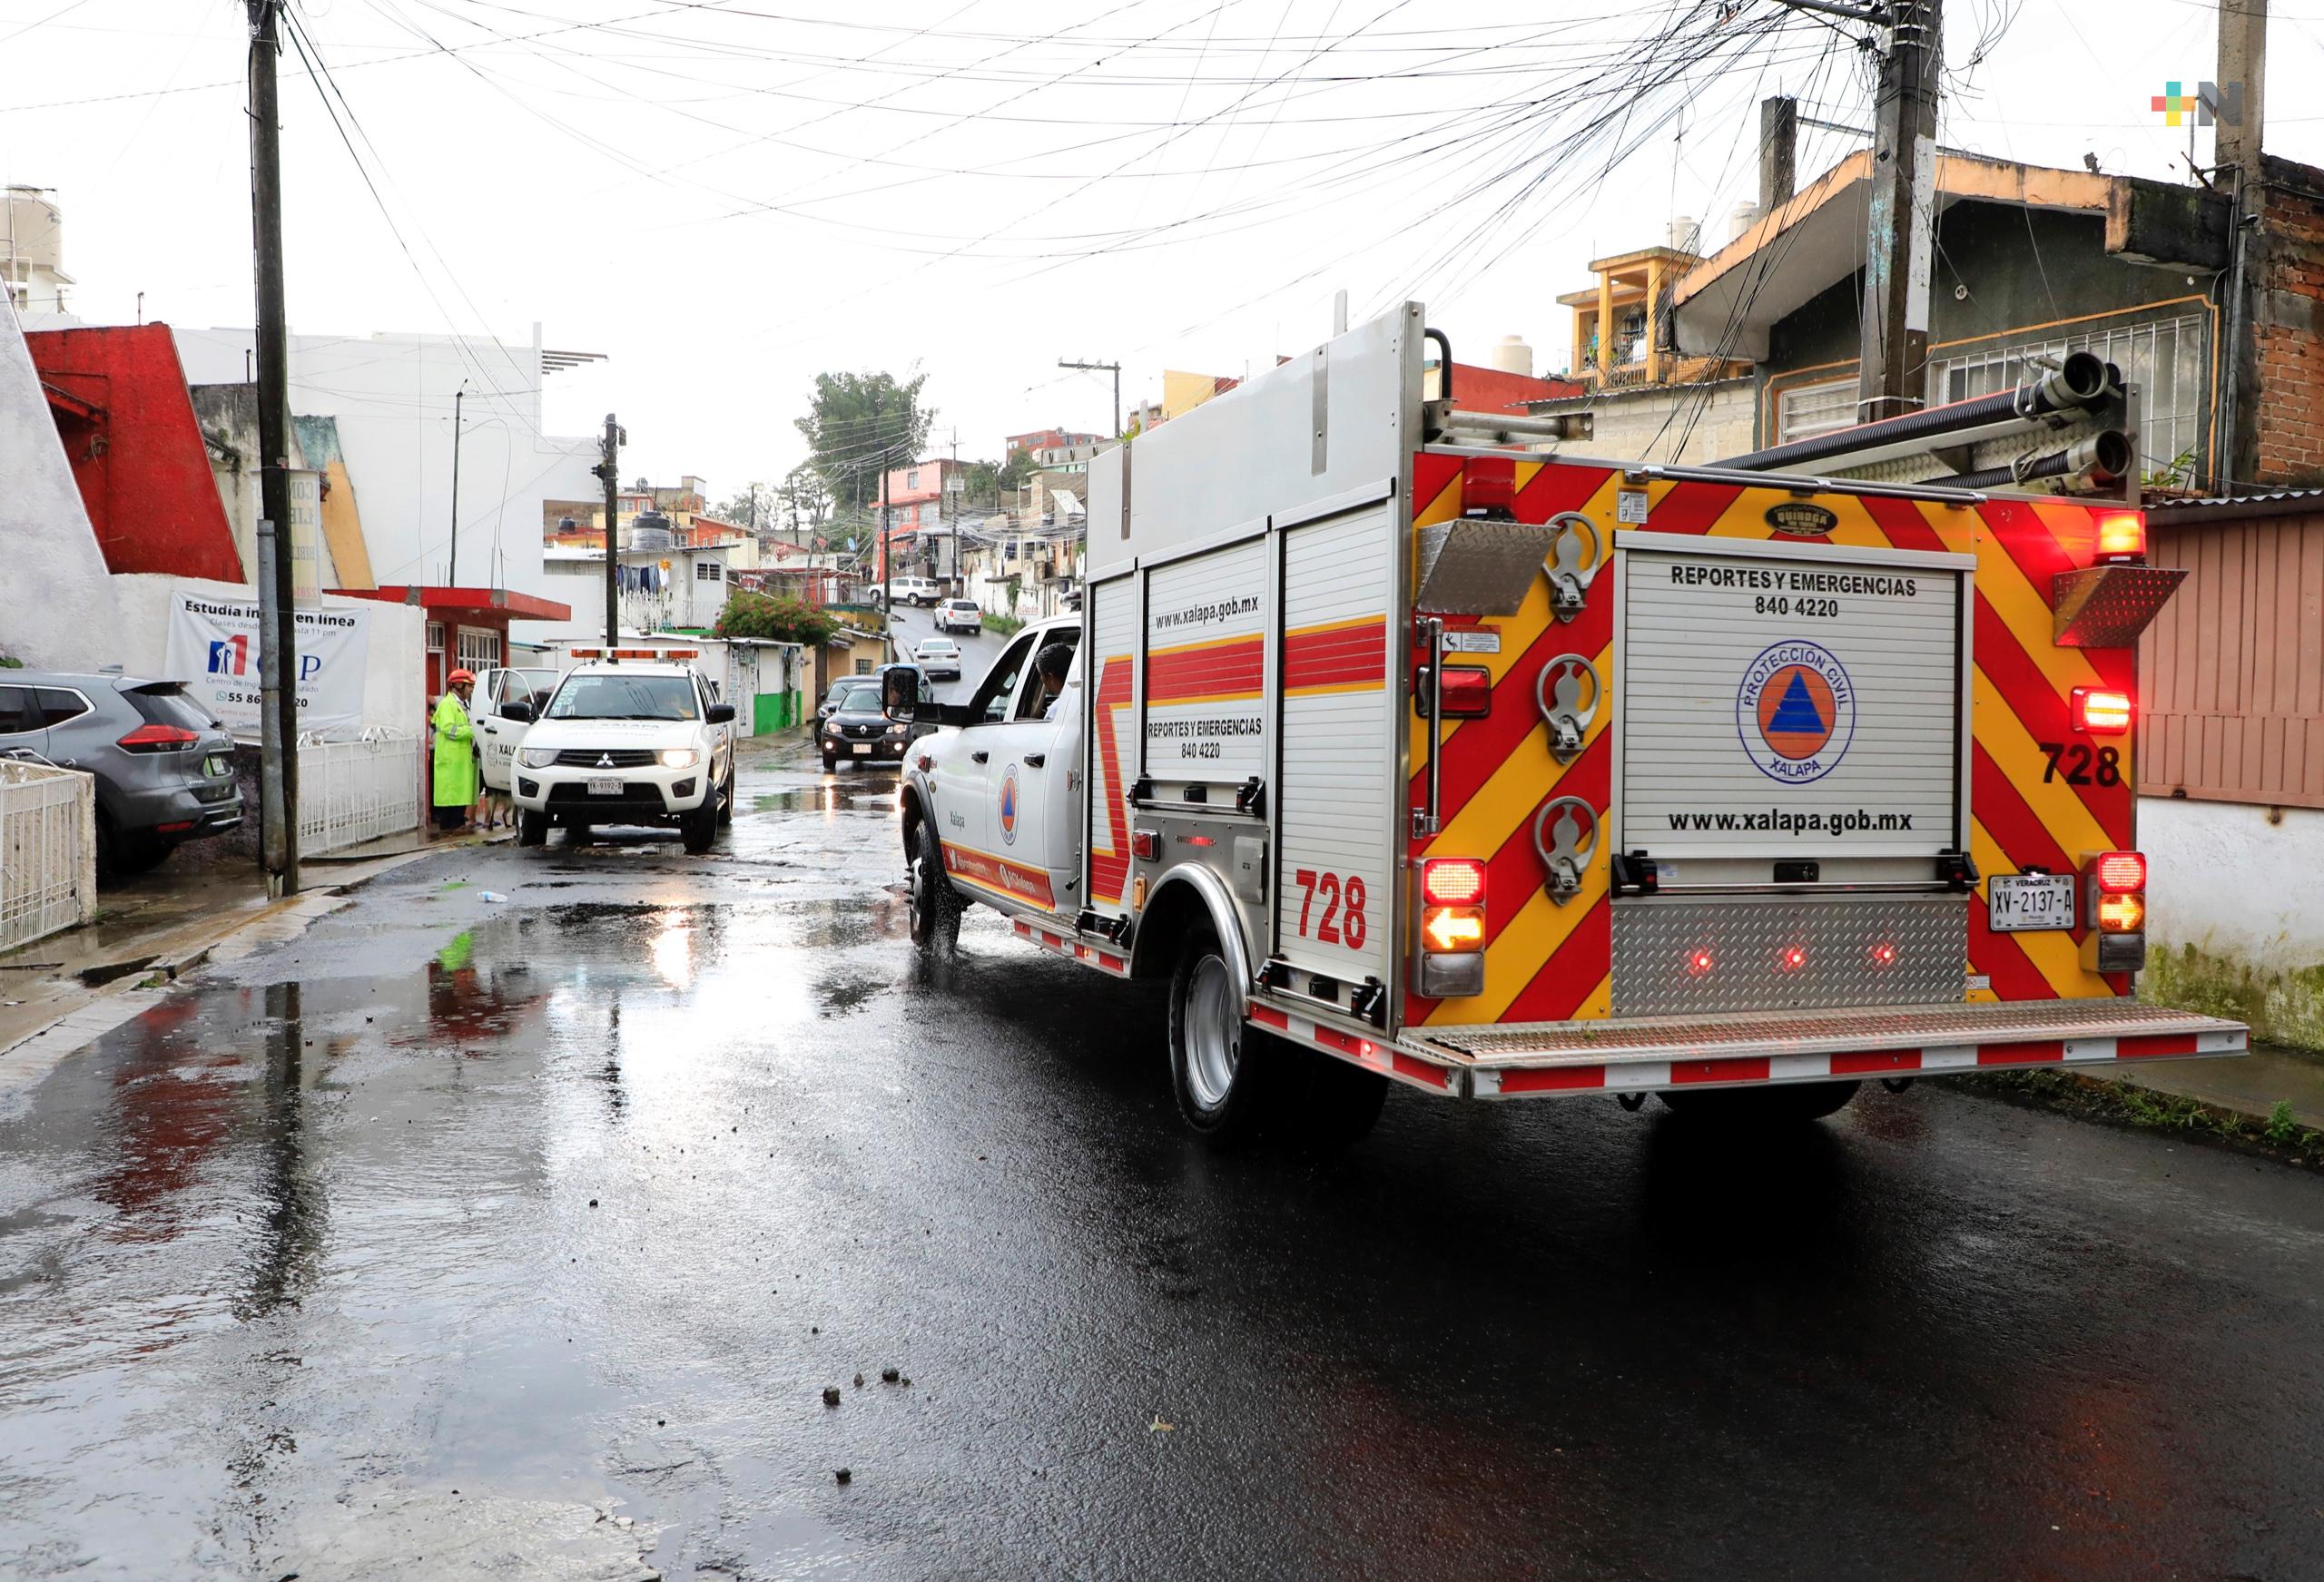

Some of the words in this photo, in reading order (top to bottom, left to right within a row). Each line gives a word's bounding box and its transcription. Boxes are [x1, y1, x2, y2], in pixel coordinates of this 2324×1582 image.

[1671, 565, 1770, 590] REPORTES
[1774, 572, 1787, 590] Y
[1790, 573, 1916, 596] EMERGENCIAS
[185, 600, 241, 617] Estudia
[296, 614, 314, 624] en
[319, 614, 355, 626] línea
[1156, 595, 1259, 629] www.xalapa.gob.mx
[1755, 596, 1788, 615] 840
[1795, 598, 1838, 618] 4220
[228, 692, 242, 703] 55
[246, 693, 261, 704] 86
[1827, 667, 1849, 710] CIVIL
[1147, 722, 1189, 738] REPORTES
[1189, 720, 1196, 737] Y
[1196, 718, 1262, 736] EMERGENCIAS
[1181, 742, 1196, 759] 840
[1199, 742, 1220, 759] 4220
[1769, 757, 1822, 777] XALAPA
[2039, 742, 2120, 788] 728
[950, 811, 965, 831] Xalapa
[1669, 809, 1912, 836] www.xalapa.gob.mx
[2015, 879, 2051, 887] VERACRUZ
[1295, 869, 1366, 950] 728
[1995, 889, 2072, 914] XV-2137-A
